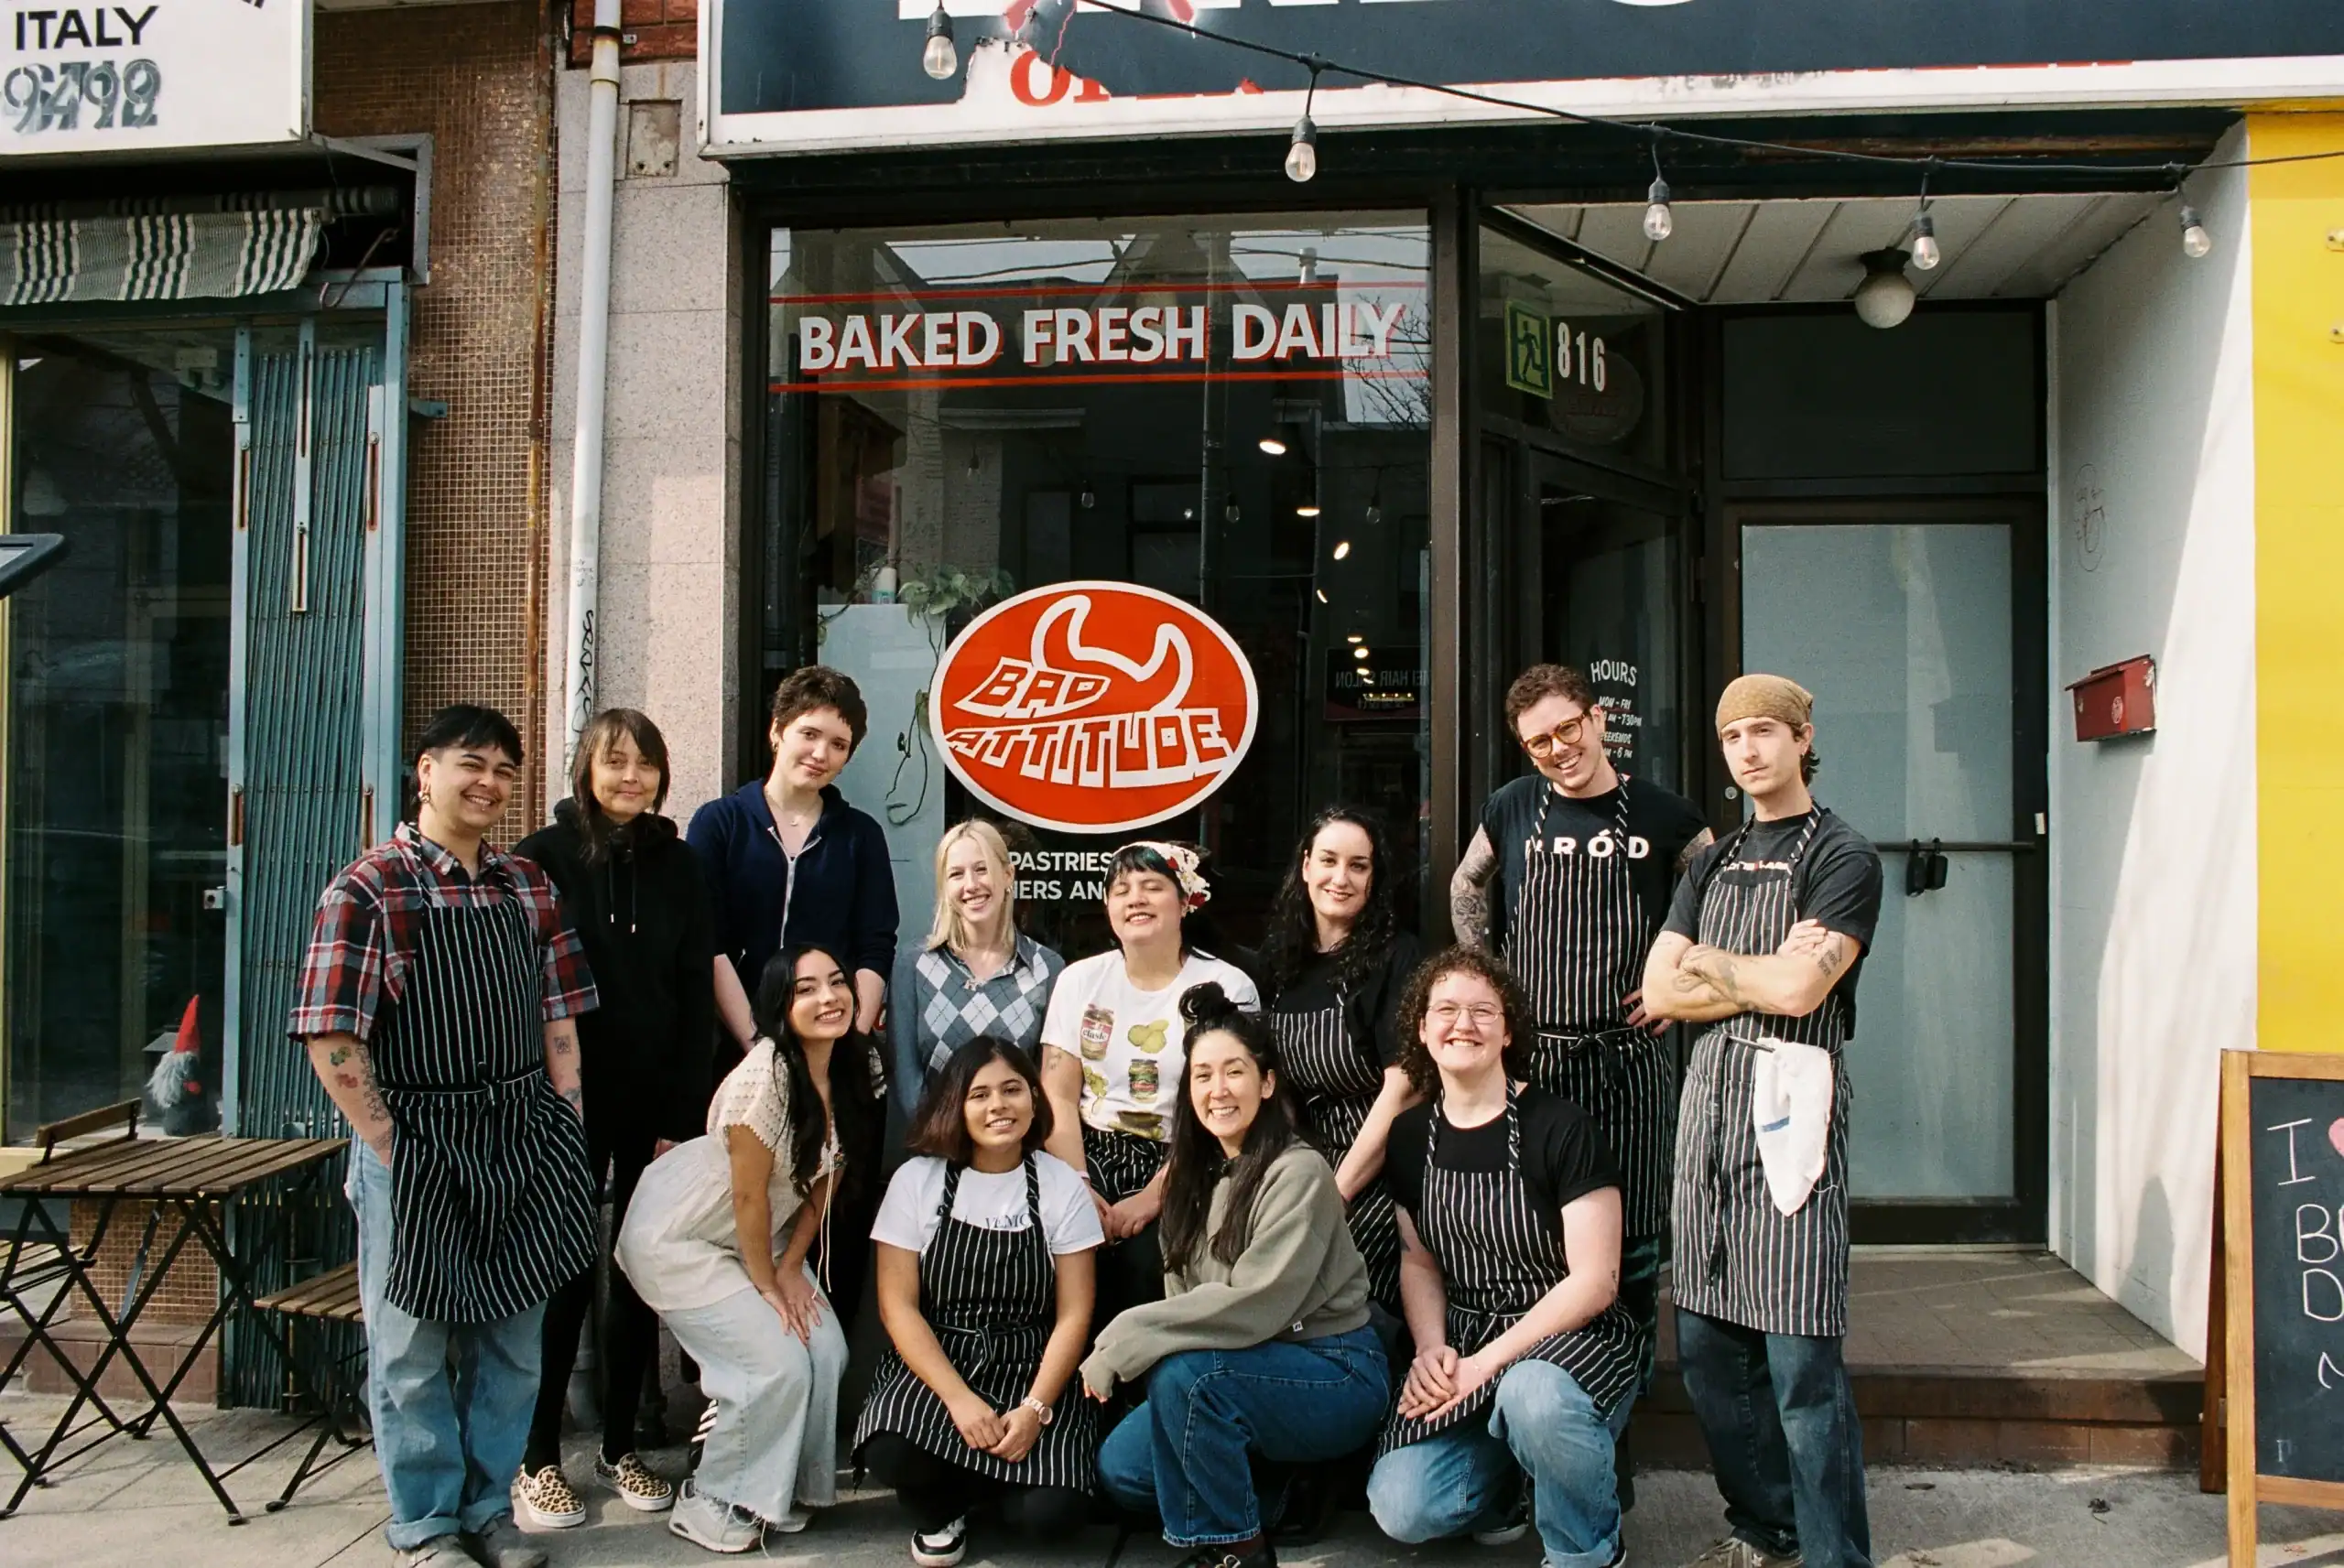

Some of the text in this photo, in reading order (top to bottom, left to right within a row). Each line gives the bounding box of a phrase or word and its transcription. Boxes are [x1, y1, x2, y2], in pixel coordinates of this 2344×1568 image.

[16, 5, 159, 50] ITALY
[799, 303, 1405, 373] BAKED FRESH DAILY
[1557, 322, 1605, 392] 816
[953, 656, 1112, 719] BAD
[1590, 659, 1637, 687] HOURS
[945, 708, 1236, 788] ATTITUDE
[1069, 880, 1103, 900] AN
[2267, 1118, 2316, 1186] I
[2295, 1204, 2344, 1264] B
